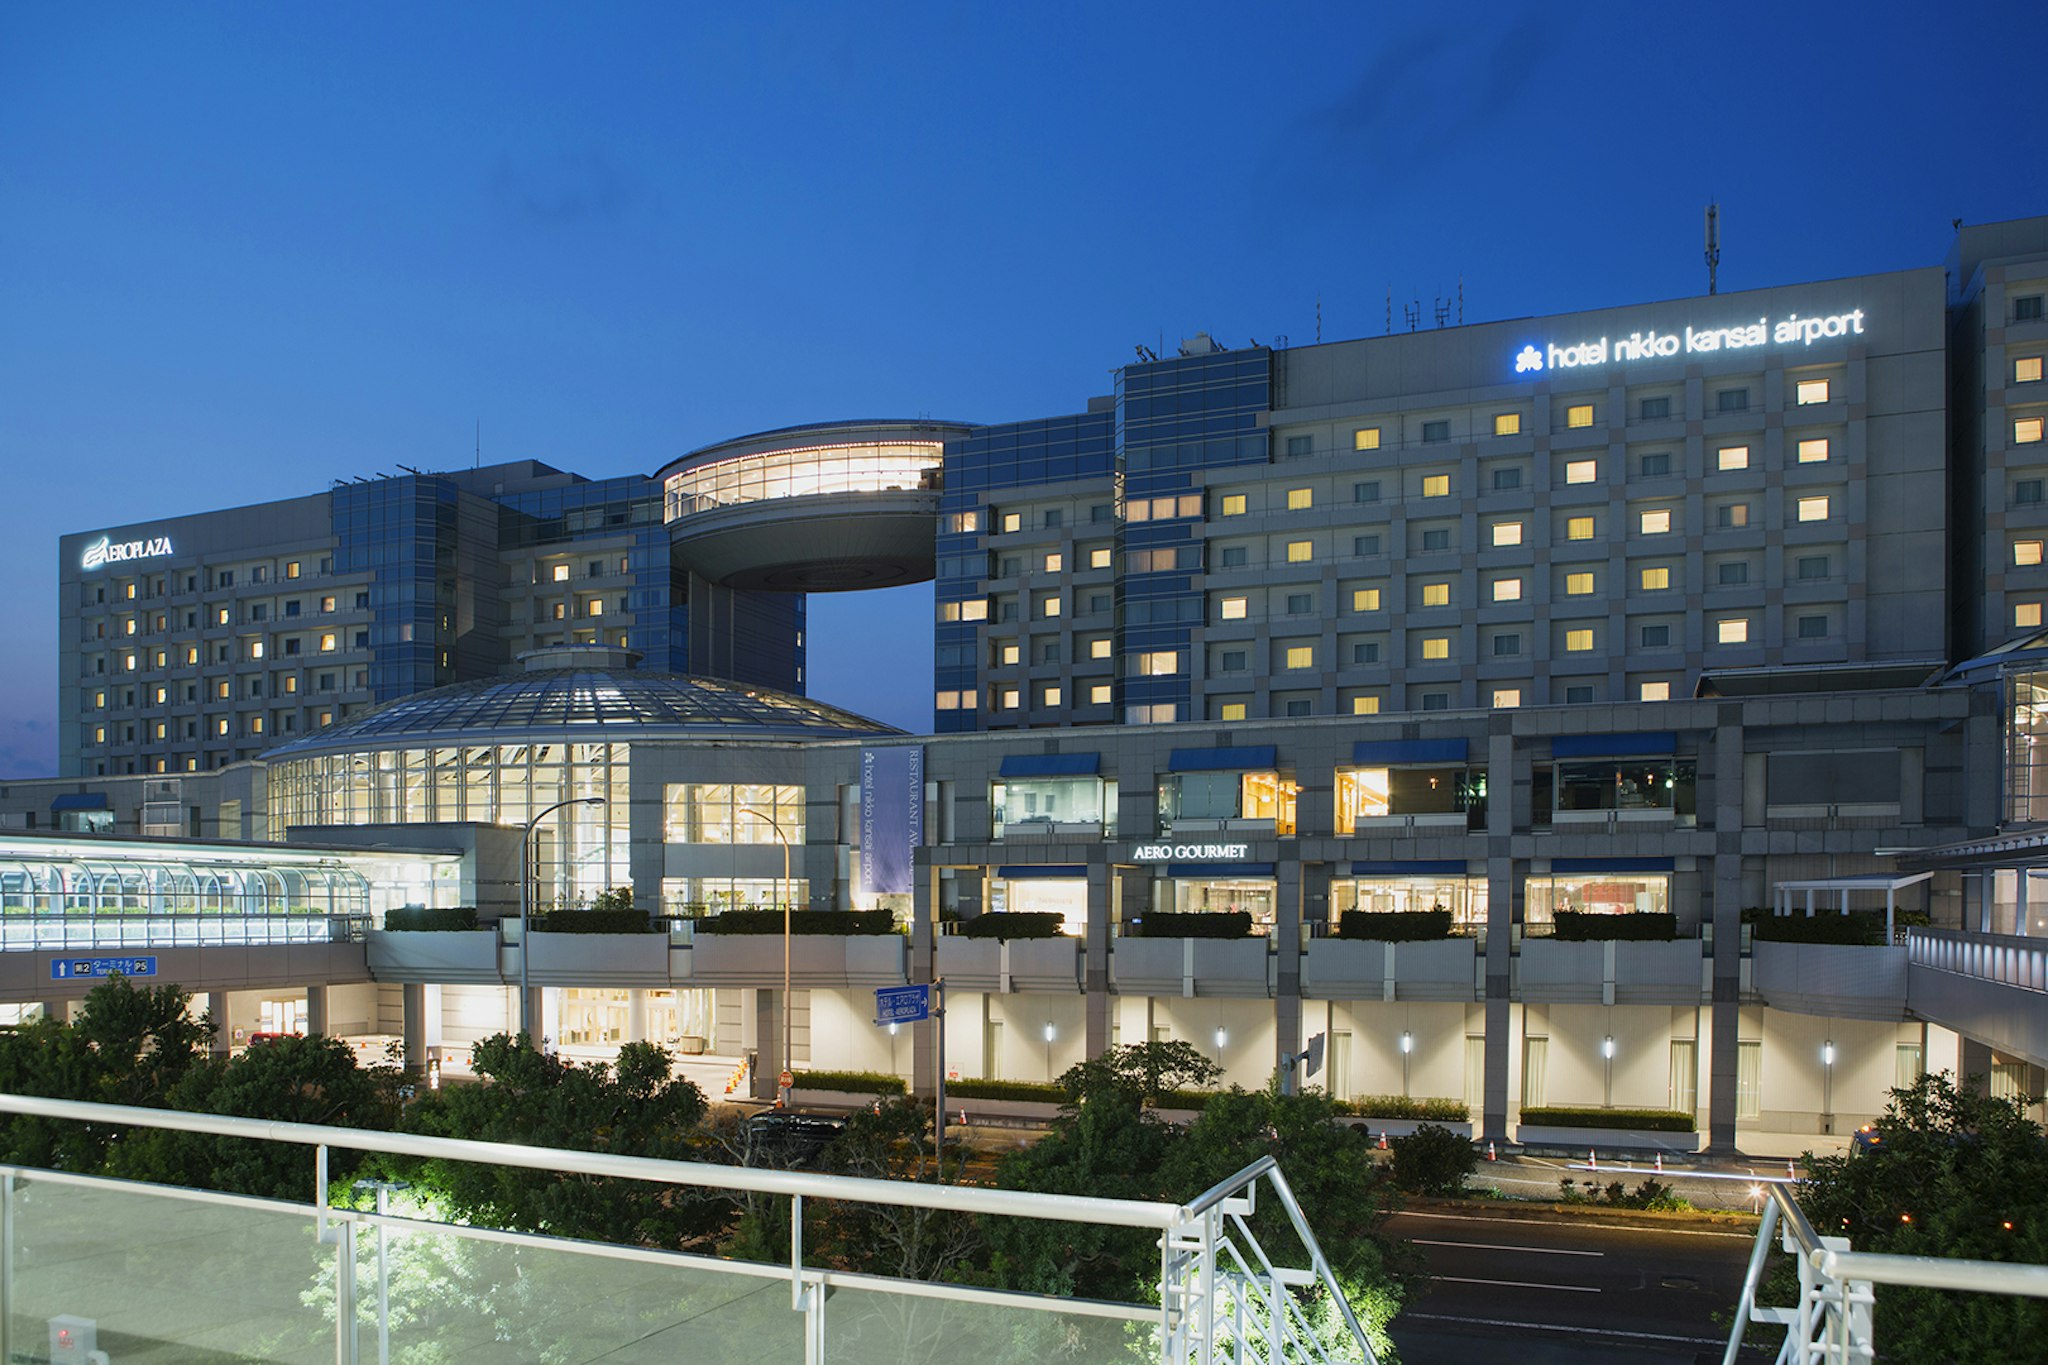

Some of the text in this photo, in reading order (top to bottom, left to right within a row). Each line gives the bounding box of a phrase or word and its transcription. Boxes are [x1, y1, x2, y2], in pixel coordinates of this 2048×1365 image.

[1547, 309, 1865, 369] hotel nikko kansai airport
[101, 537, 173, 563] AEROPLAZA
[908, 750, 919, 827] RESTAURANT
[862, 765, 875, 885] hotel nikko kansai airport
[1133, 844, 1248, 859] AERO GOURMET
[92, 960, 133, 969] ターミナル
